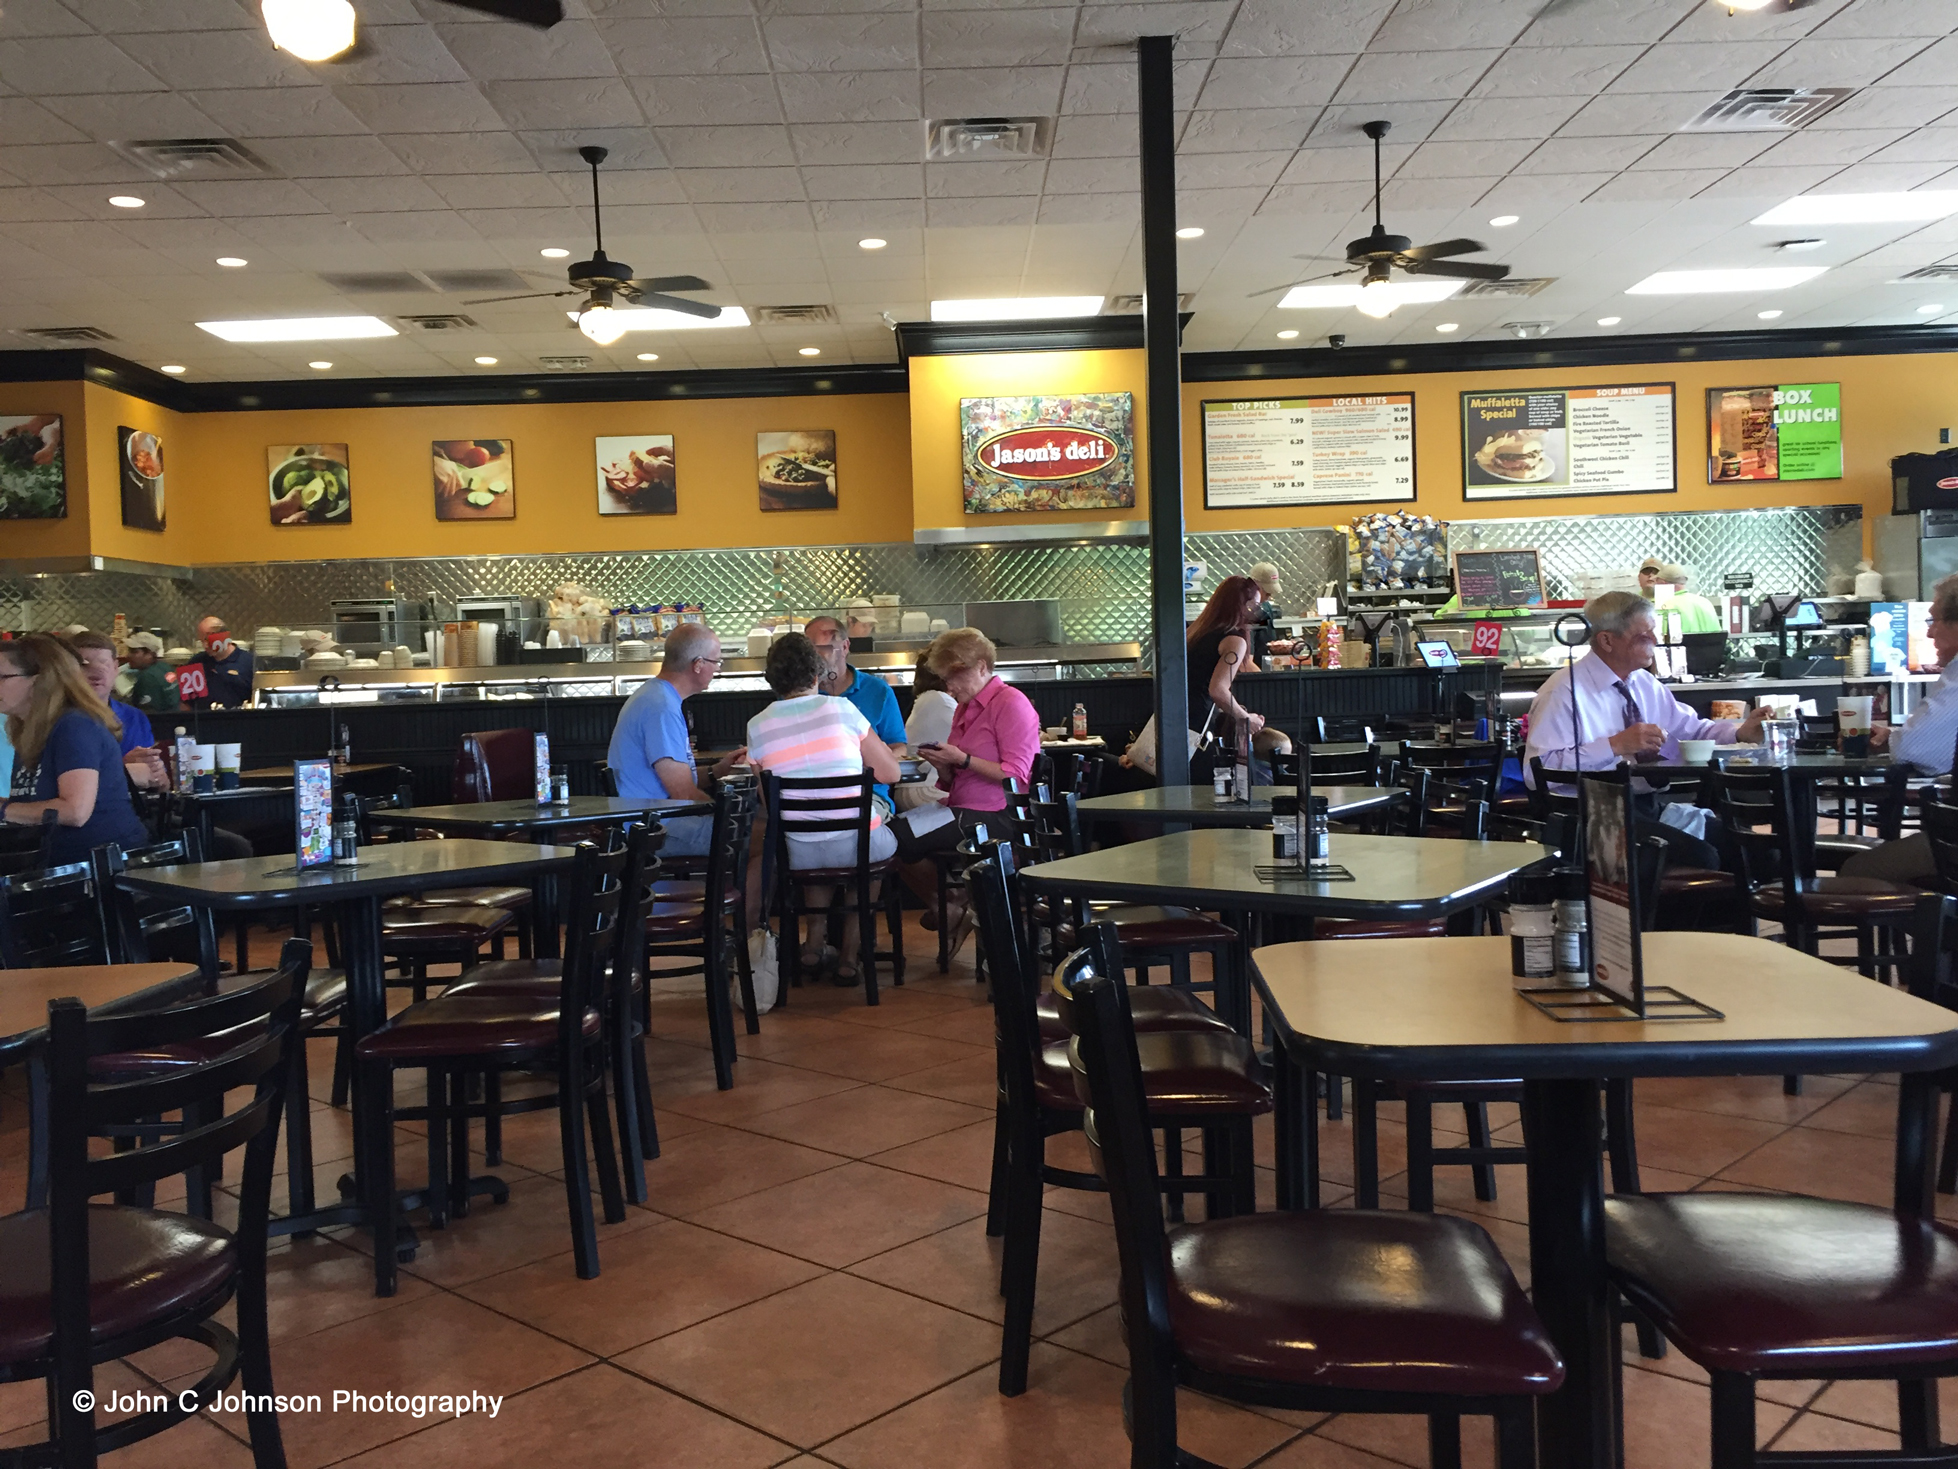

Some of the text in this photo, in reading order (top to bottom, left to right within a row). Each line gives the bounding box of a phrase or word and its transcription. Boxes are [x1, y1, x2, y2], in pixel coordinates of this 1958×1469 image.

[1253, 401, 1280, 409] PICKS
[1333, 398, 1363, 406] LOCAL
[1471, 397, 1525, 408] Muffaletta
[1773, 390, 1812, 405] BOX
[1480, 408, 1516, 421] Special
[1773, 408, 1838, 423] LUNCH
[991, 440, 1105, 468] Jason's deli
[1476, 627, 1498, 648] 92
[180, 670, 204, 694] 20
